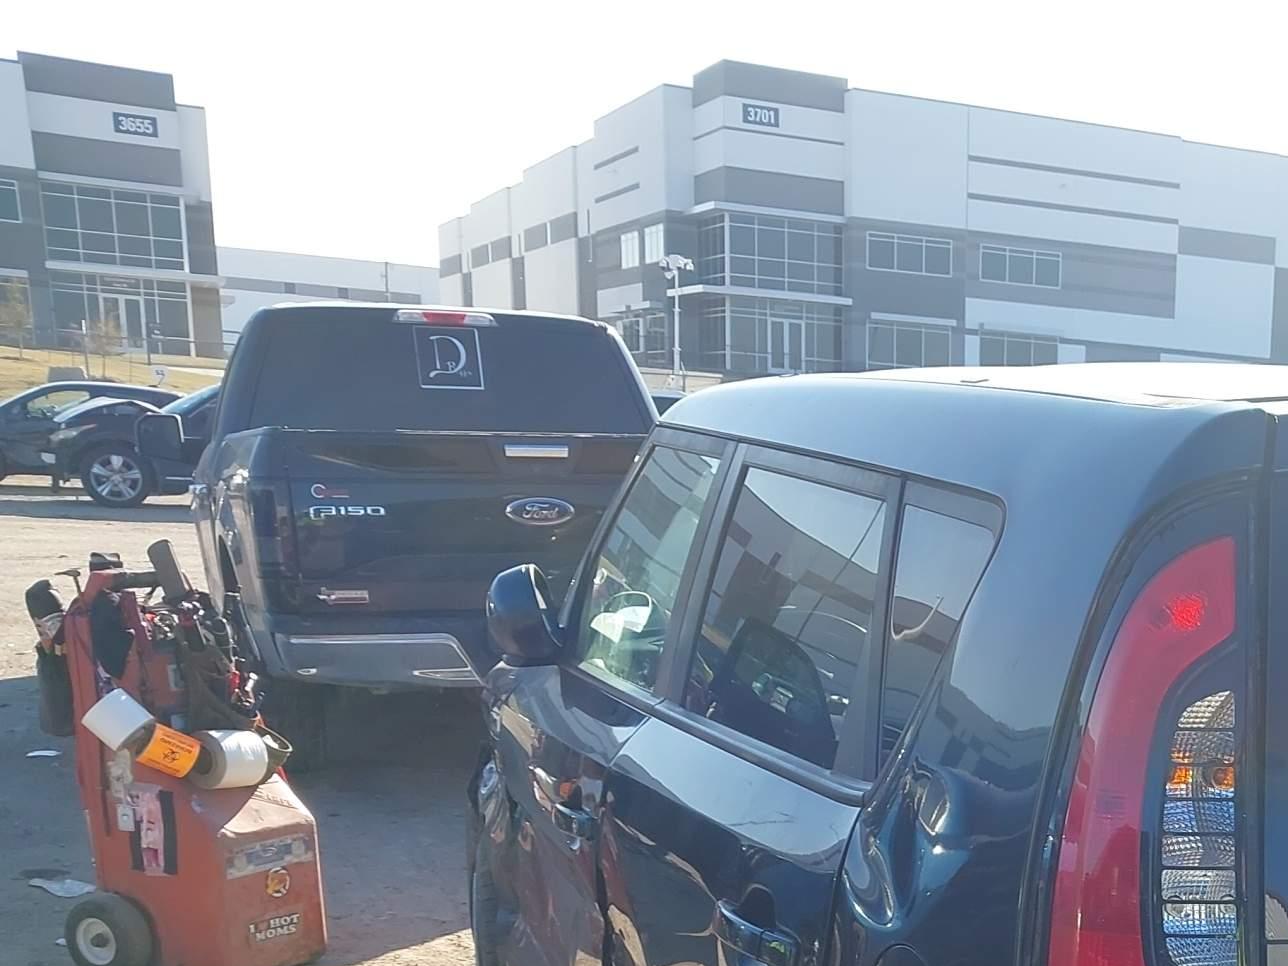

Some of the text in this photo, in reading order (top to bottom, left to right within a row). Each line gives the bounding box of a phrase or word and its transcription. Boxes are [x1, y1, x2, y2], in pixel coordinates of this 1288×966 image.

[747, 107, 775, 124] 3701
[118, 116, 153, 134] 3655
[522, 502, 560, 519] Ford
[270, 913, 300, 929] HOT
[255, 924, 297, 942] MOMS
